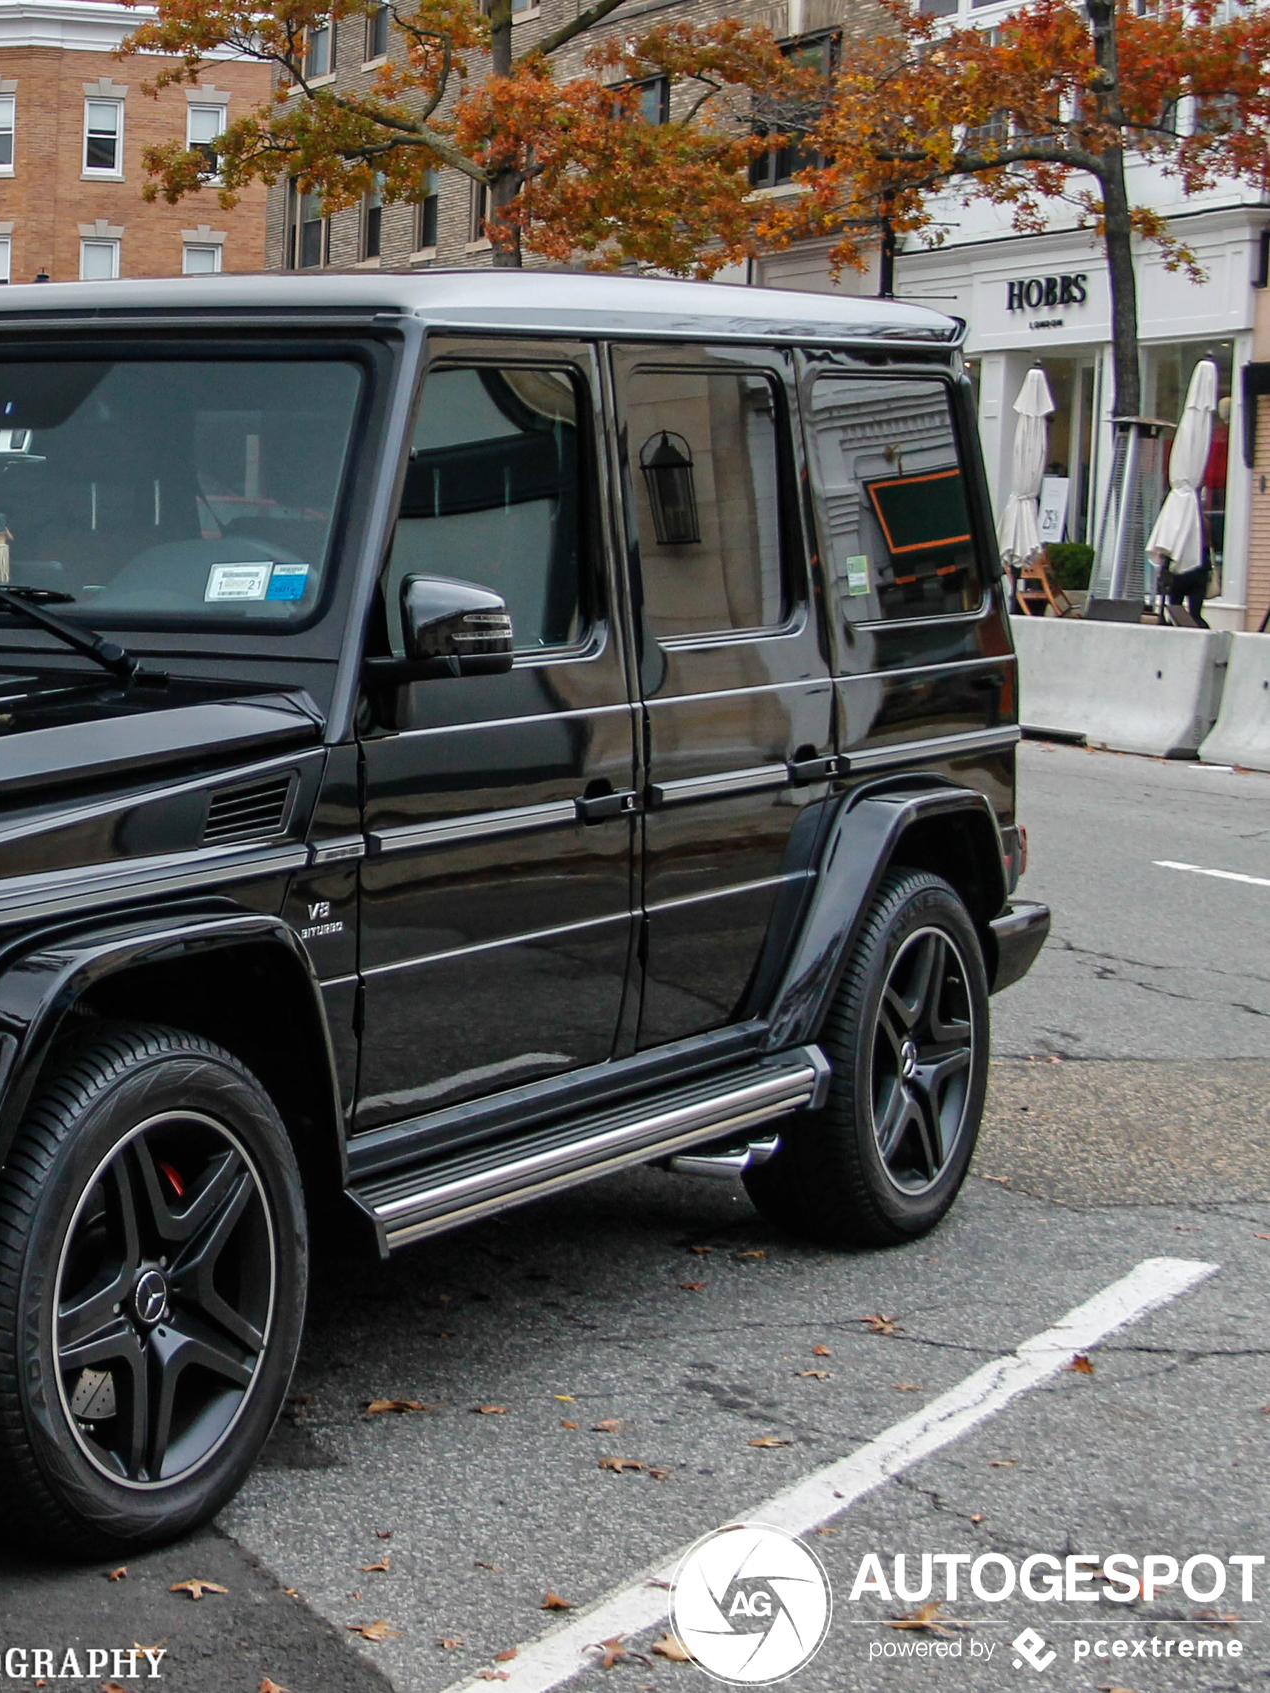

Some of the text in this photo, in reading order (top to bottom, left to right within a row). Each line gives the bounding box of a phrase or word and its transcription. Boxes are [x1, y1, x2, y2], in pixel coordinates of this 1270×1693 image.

[1005, 273, 1087, 311] HOBBS
[1028, 319, 1063, 329] LONDON
[307, 901, 330, 920] V8
[301, 921, 343, 939] BITURBO
